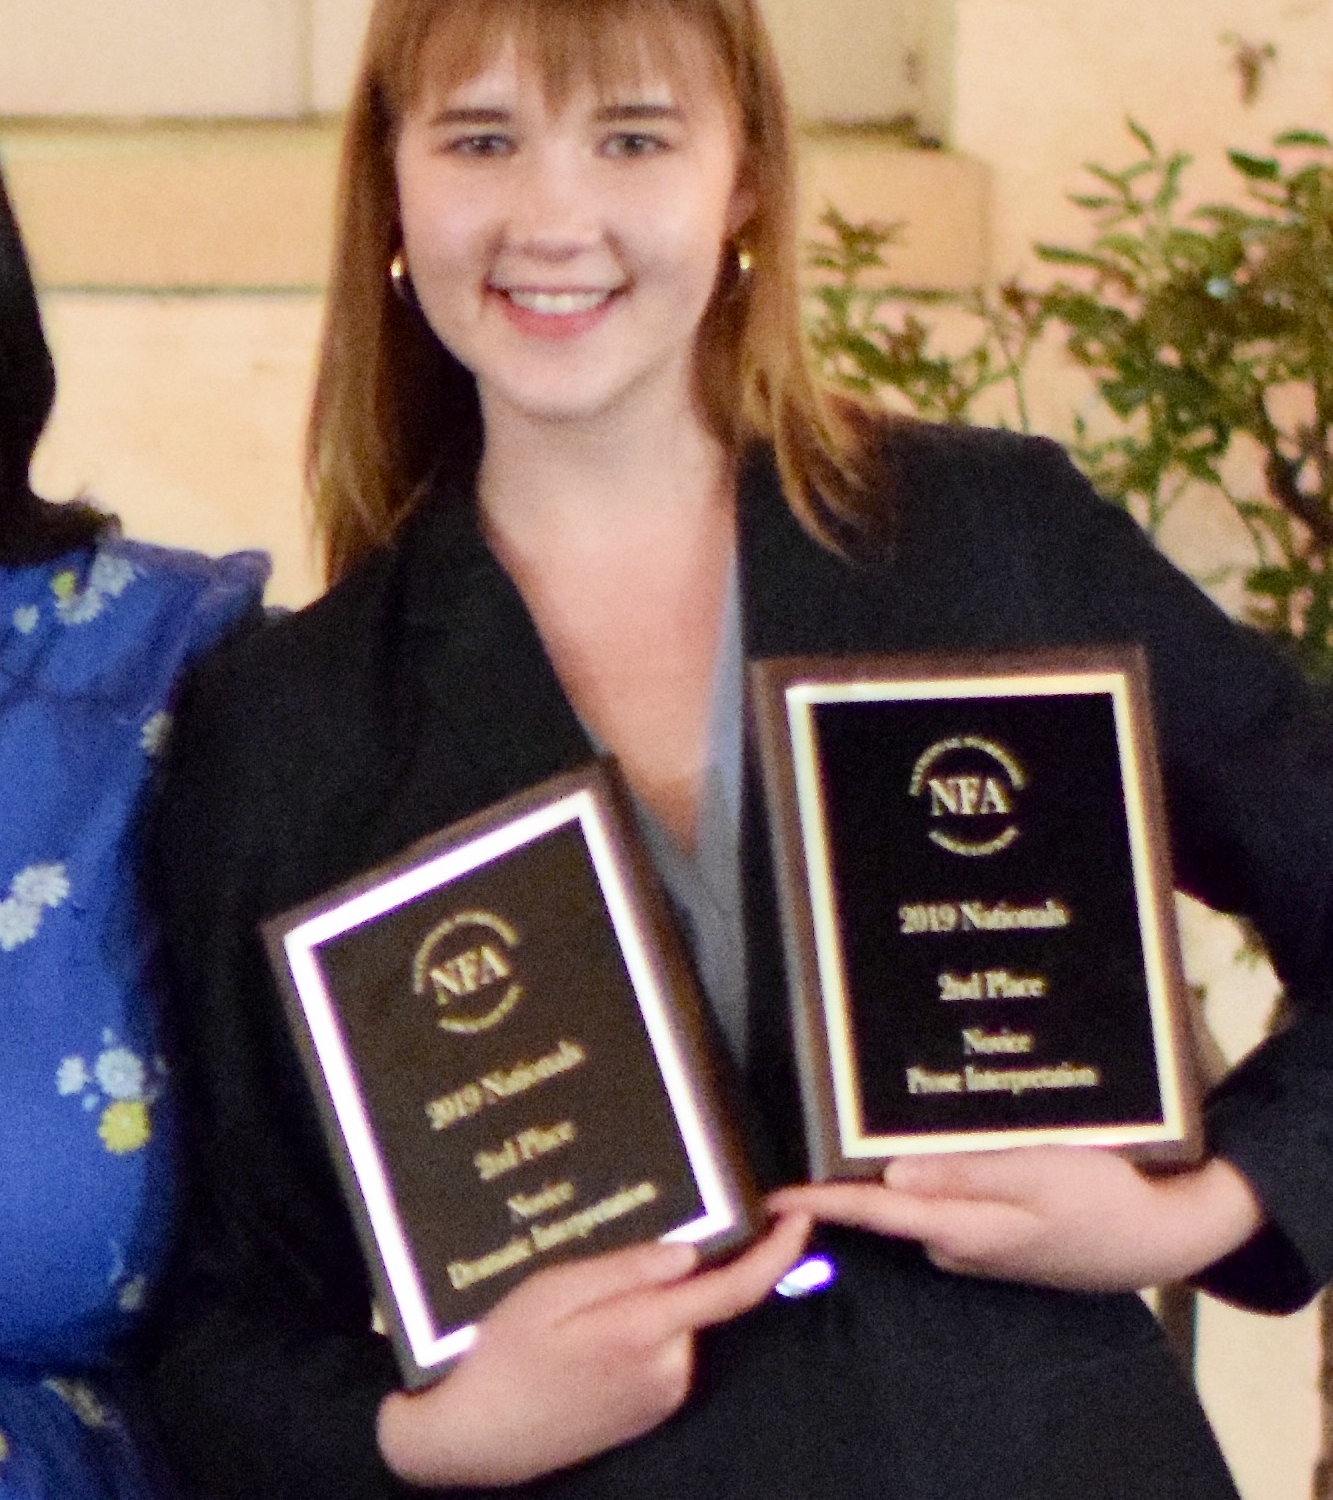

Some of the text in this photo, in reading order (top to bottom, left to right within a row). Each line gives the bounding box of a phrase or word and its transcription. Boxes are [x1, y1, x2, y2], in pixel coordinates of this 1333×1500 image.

[928, 777, 1010, 816] NFA
[898, 900, 1070, 933] 2019 Nationals
[430, 946, 510, 1005] NFA
[937, 970, 1046, 1000] 2nd Place
[963, 1029, 1031, 1054] Novice
